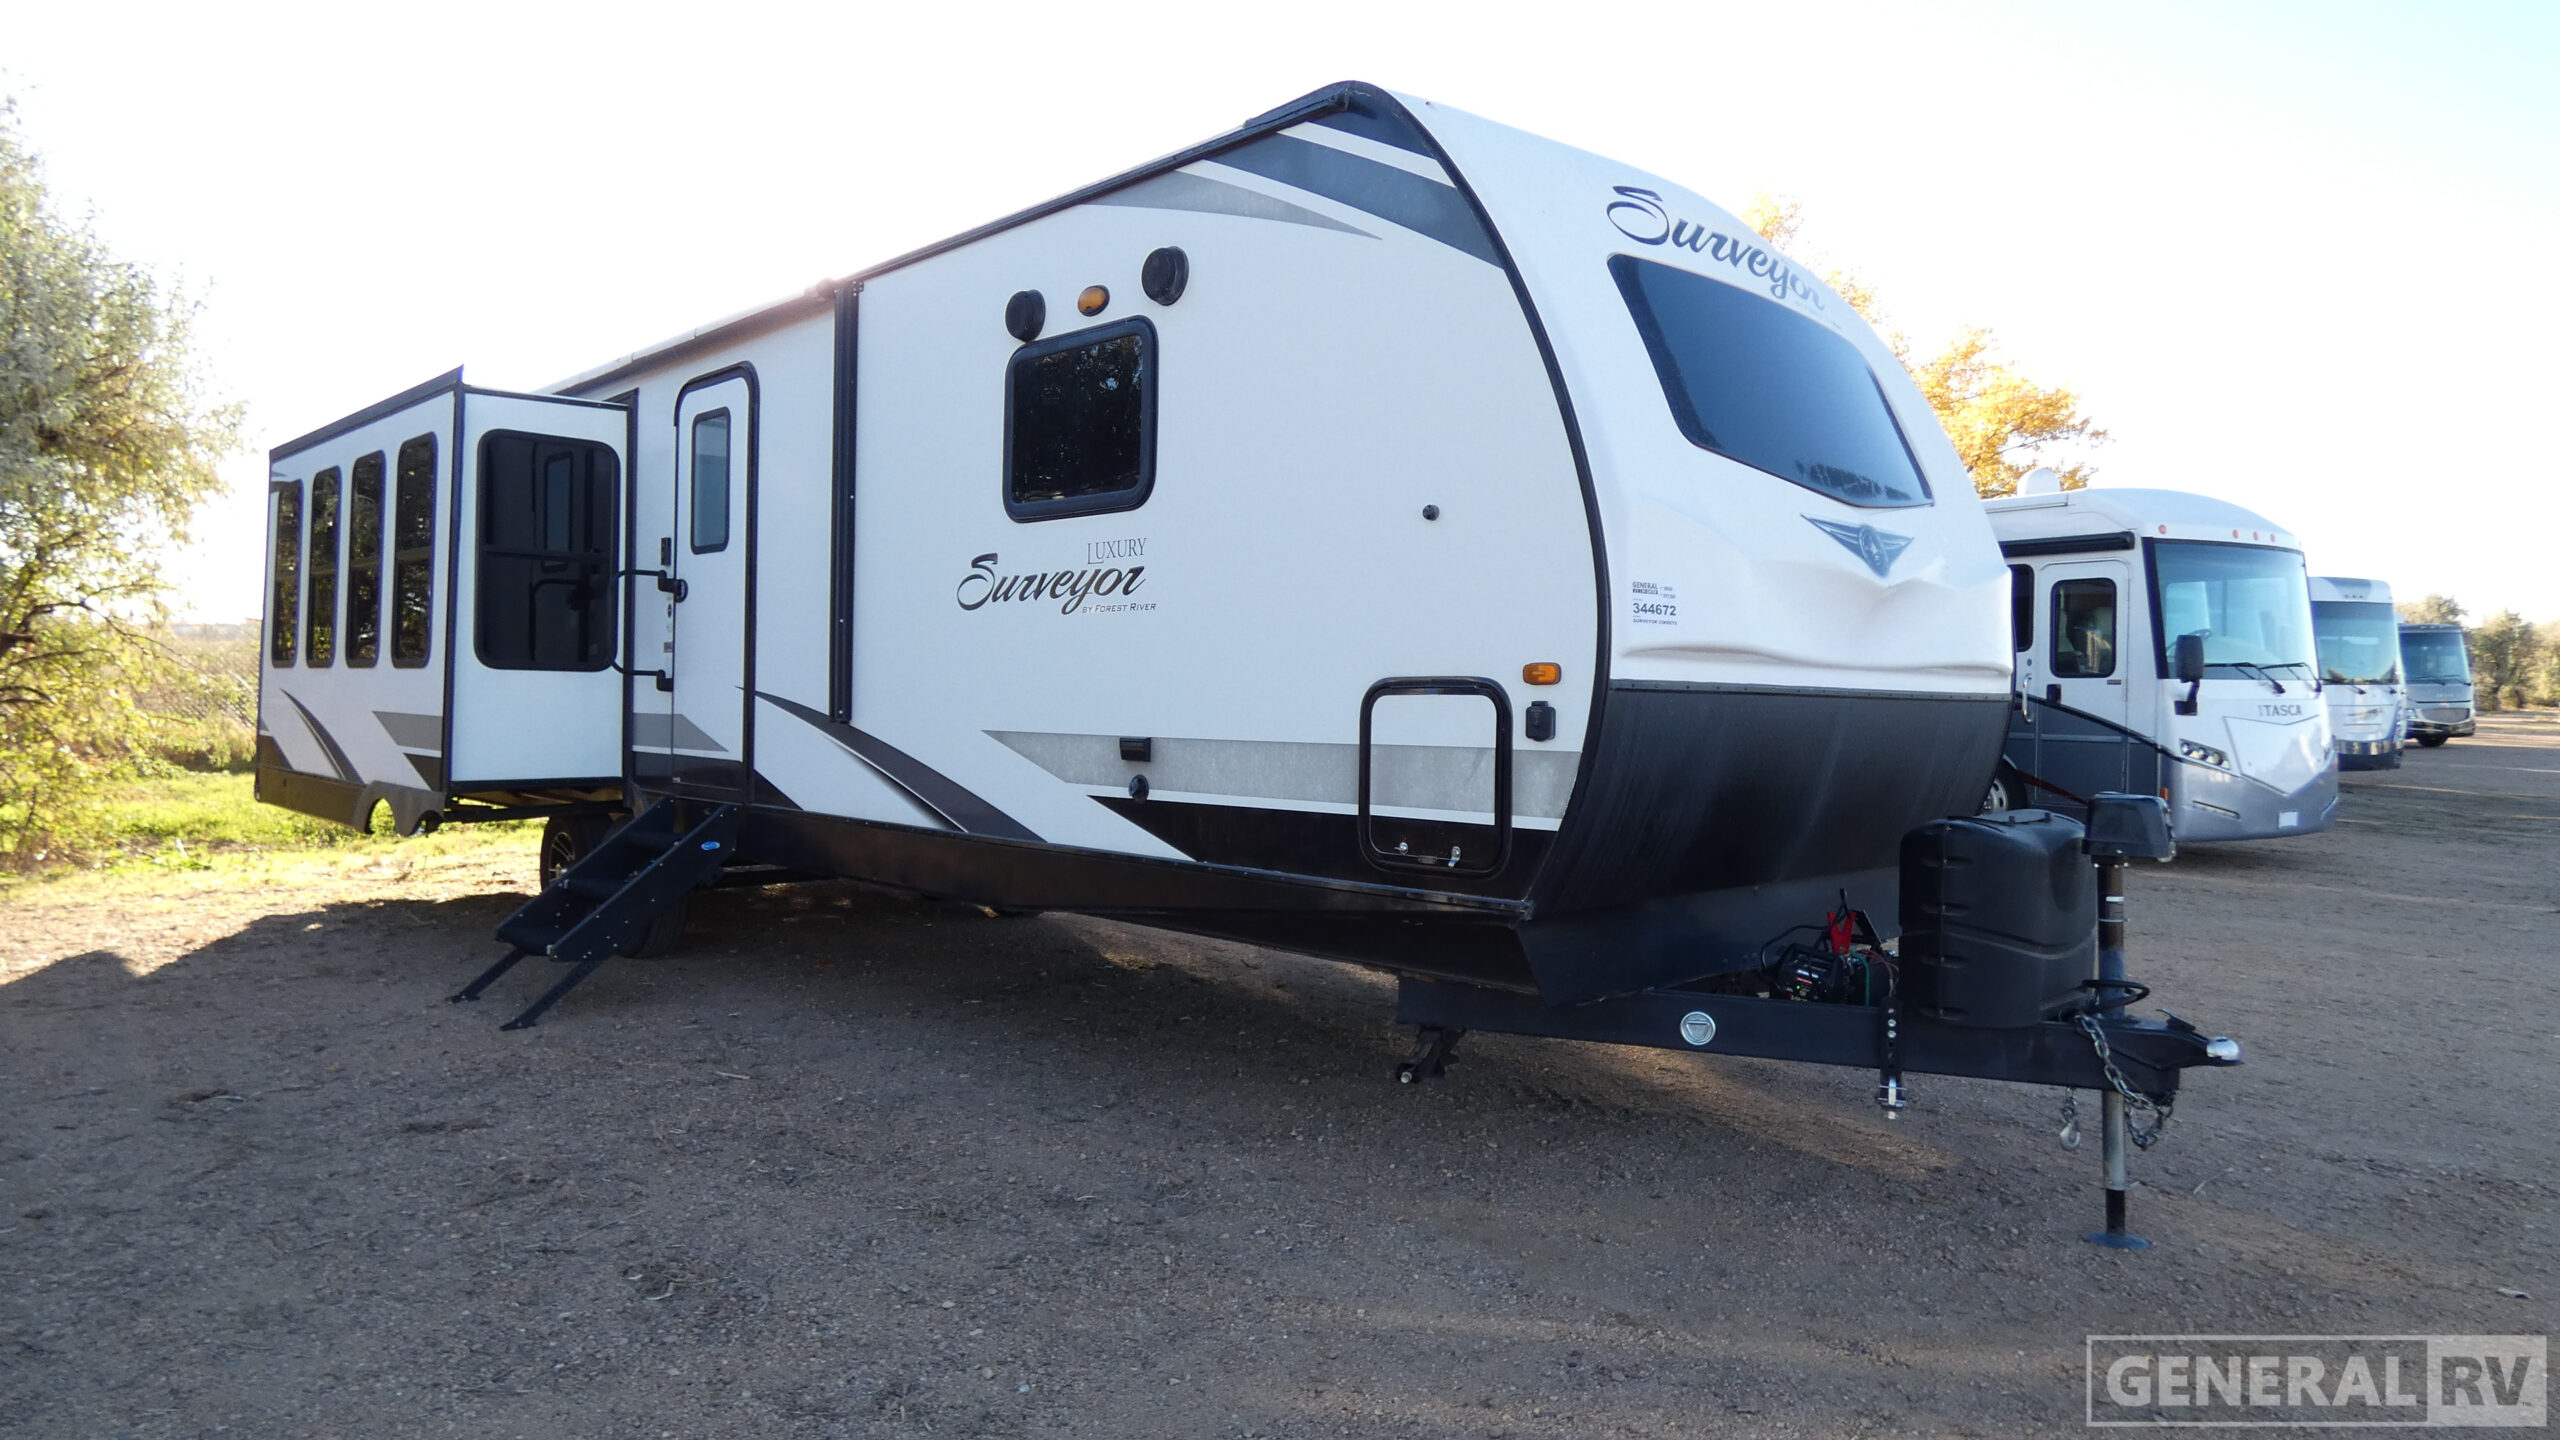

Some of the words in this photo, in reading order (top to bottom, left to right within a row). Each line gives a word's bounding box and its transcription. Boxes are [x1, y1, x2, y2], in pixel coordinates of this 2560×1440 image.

[1606, 185, 1825, 310] Surveyor
[1087, 537, 1147, 565] LUXURY
[956, 552, 1146, 615] Surveyor
[1082, 606, 1093, 614] BY
[1095, 604, 1128, 613] FOREST
[1130, 602, 1157, 612] RIVER
[1633, 602, 1676, 616] 344672
